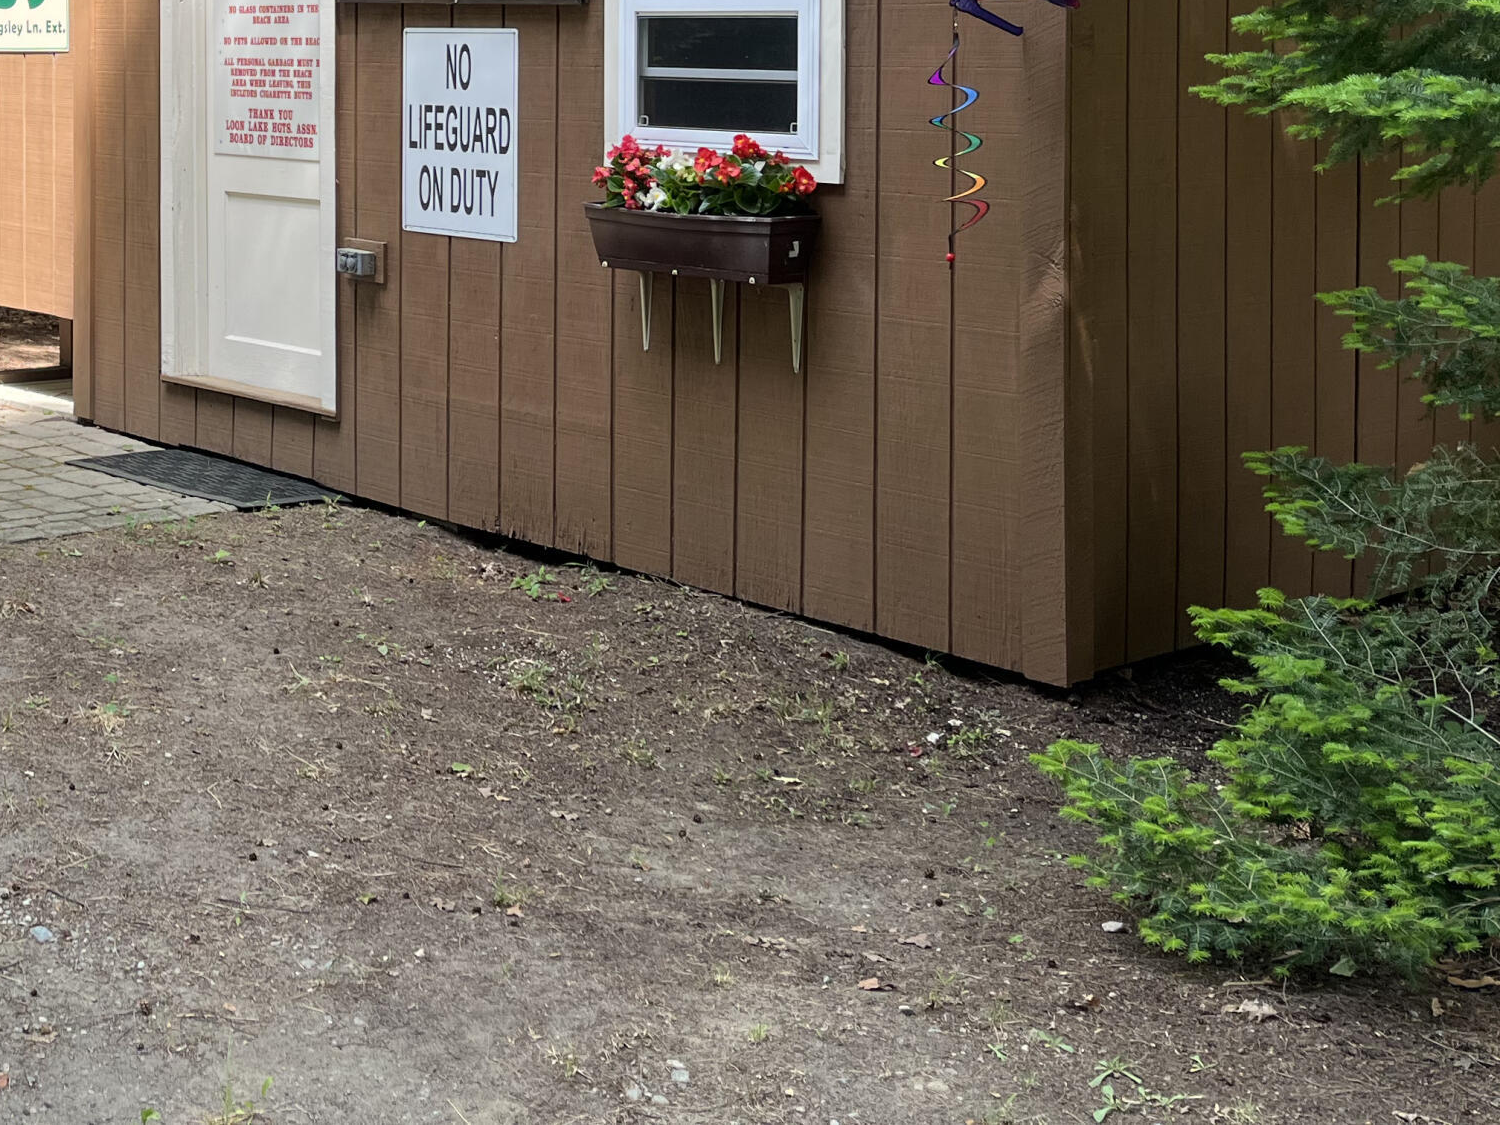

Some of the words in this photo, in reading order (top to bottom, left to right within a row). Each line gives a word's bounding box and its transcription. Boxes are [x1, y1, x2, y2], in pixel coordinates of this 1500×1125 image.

[229, 6, 236, 14] NO
[239, 6, 256, 14] GLASS
[259, 5, 294, 13] CONTAINERS
[297, 5, 304, 13] IN
[307, 4, 319, 13] THE
[252, 16, 271, 24] BEACH
[274, 16, 289, 24] AREA
[26, 21, 42, 33] Ln.
[46, 20, 66, 33] Ext.
[224, 37, 231, 45] NO
[234, 37, 248, 45] PETS
[250, 37, 277, 45] ALLOWED
[280, 37, 288, 45] ON
[290, 37, 302, 45] THE
[305, 37, 320, 46] BEAC
[224, 58, 234, 66] ALL
[237, 58, 265, 66] PERSONAL
[268, 58, 294, 67] GARBAGE
[297, 59, 313, 67] MUST
[446, 44, 471, 91] NO
[231, 68, 257, 76] REMOVED
[260, 69, 276, 77] FROM
[279, 69, 290, 77] THE
[293, 69, 312, 78] BEACH
[249, 79, 266, 87] WHEN
[297, 80, 311, 89] THIS
[260, 90, 291, 99] CIGARETTE
[294, 91, 312, 99] BUTTS
[248, 108, 275, 119] THANK
[278, 110, 293, 120] YOU
[225, 120, 245, 131] LOON
[248, 121, 268, 132] LAKE
[272, 122, 292, 134] HGTS.
[296, 124, 317, 135] ASSN.
[409, 104, 511, 155] LIFEGUARD
[230, 133, 254, 144] BOARD
[258, 135, 267, 145] OF
[271, 135, 314, 148] DIRECTORS
[419, 164, 443, 212] ON
[450, 167, 499, 217] DUTY
